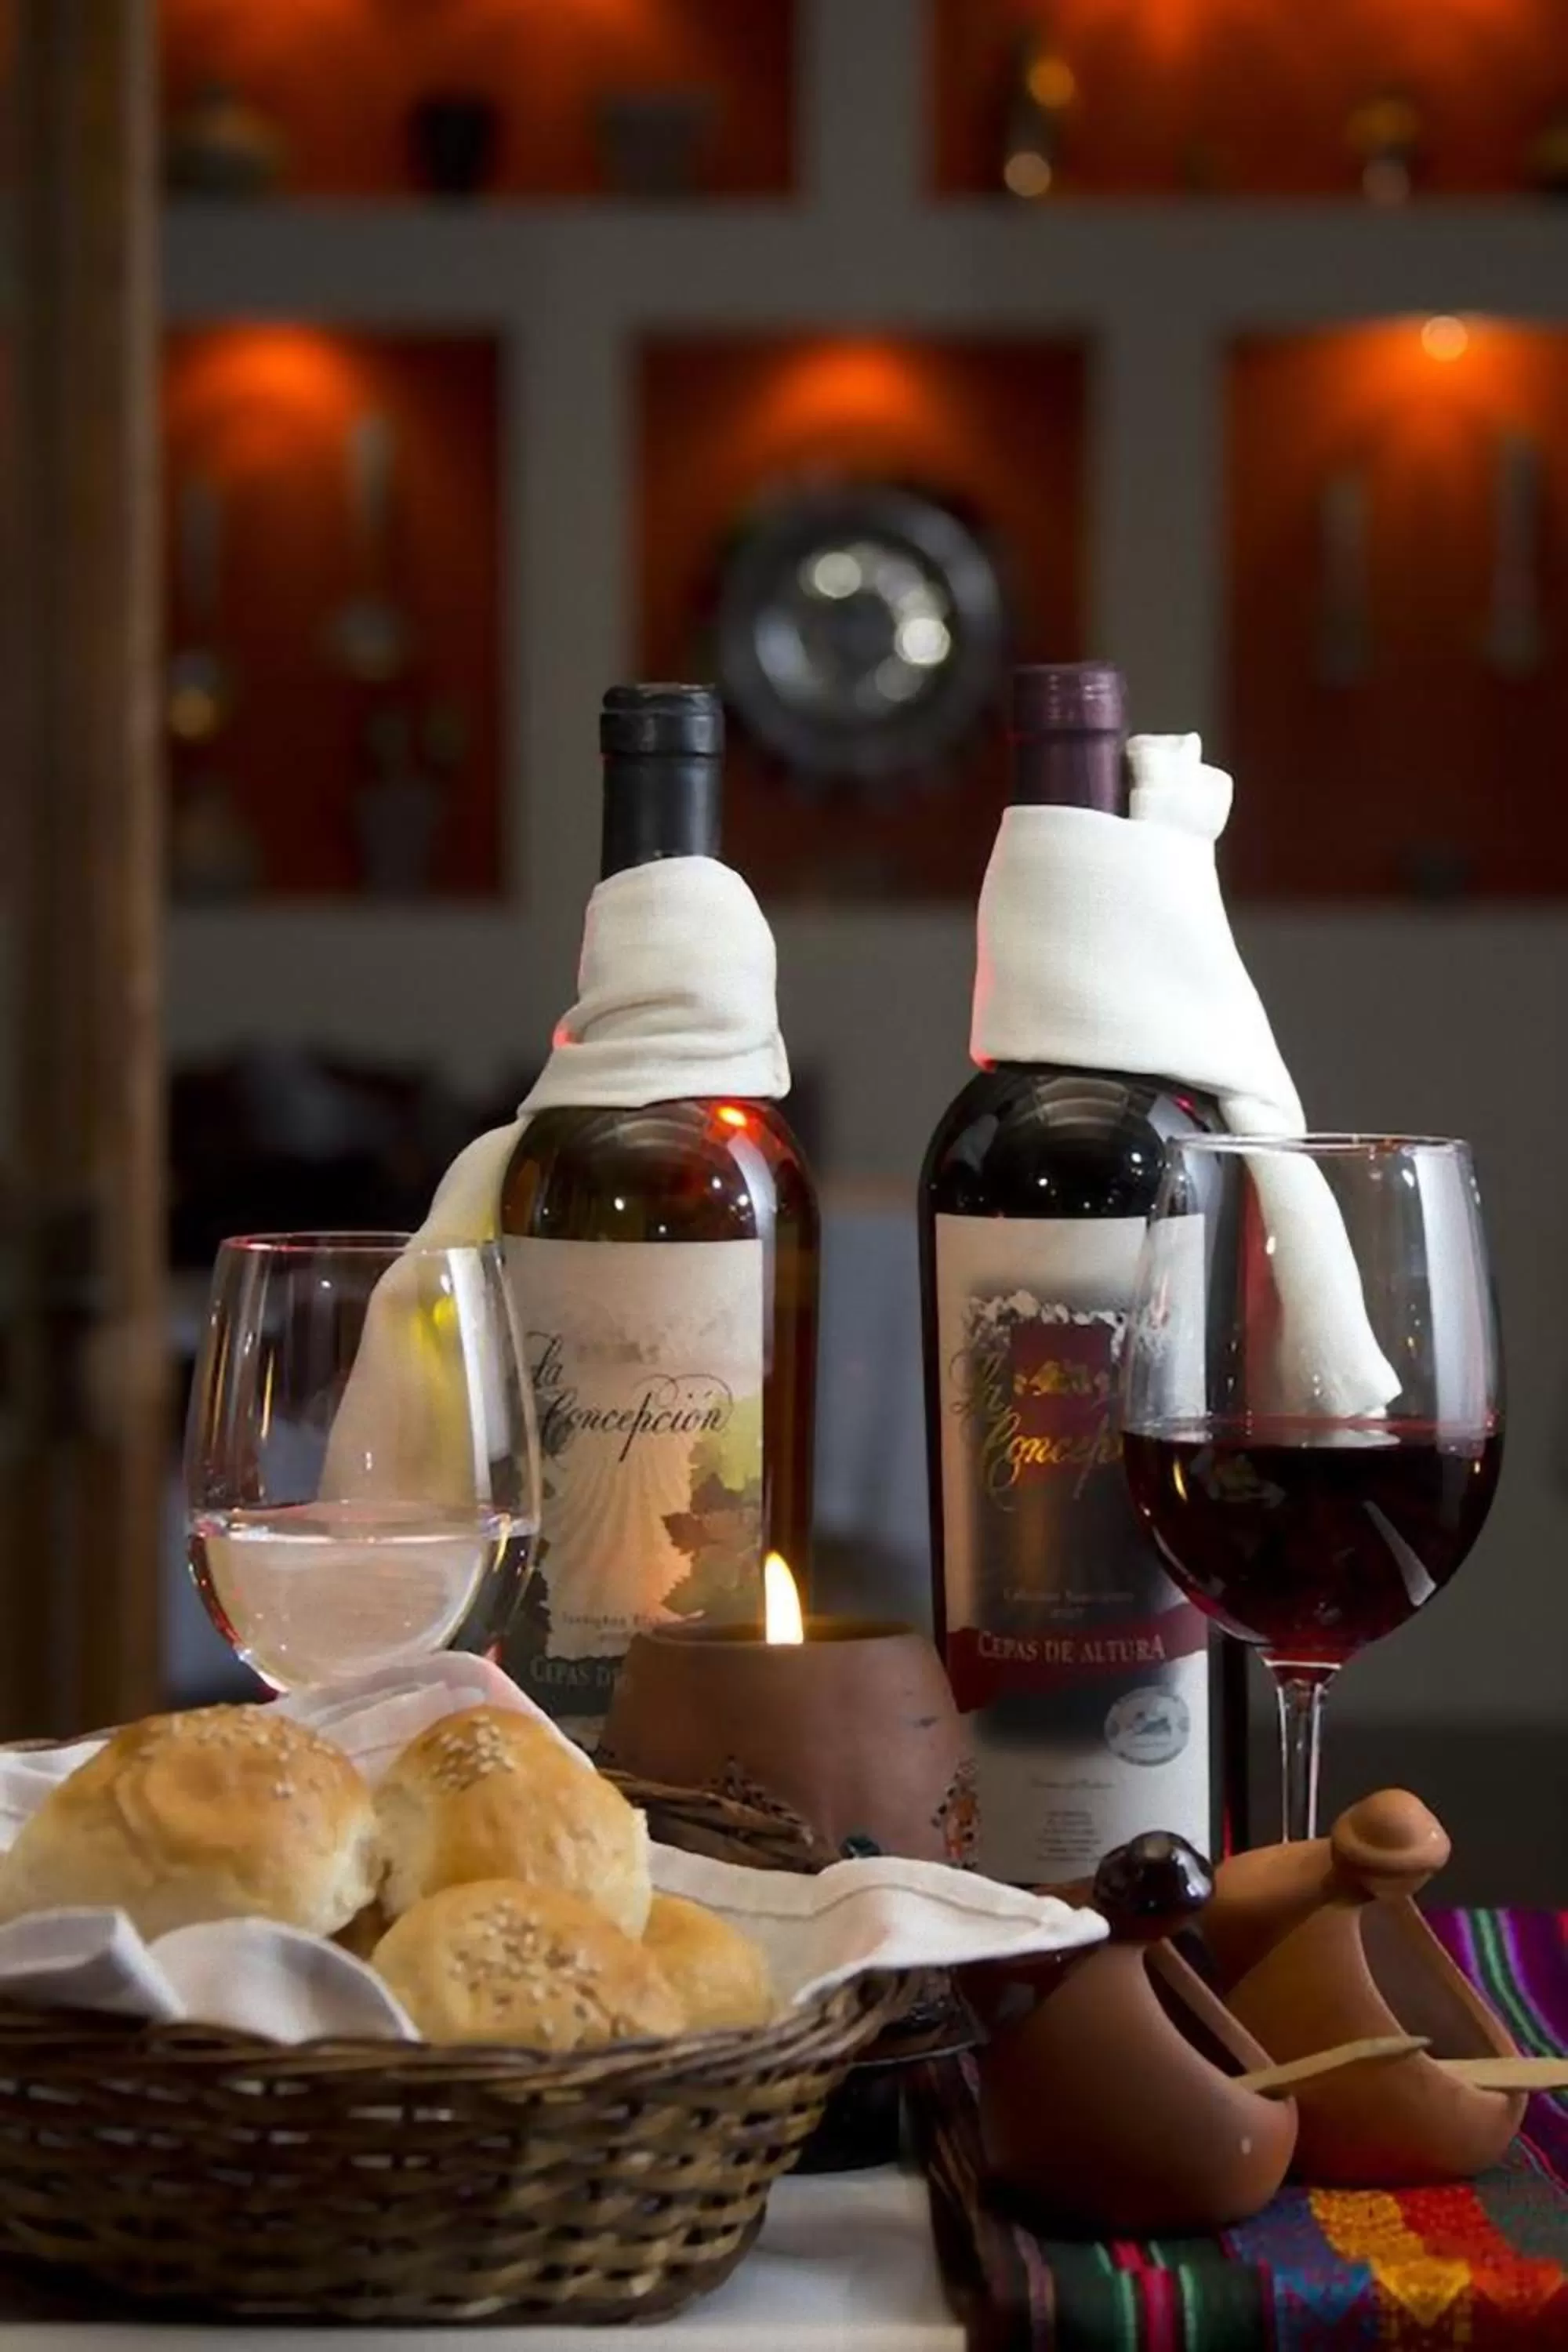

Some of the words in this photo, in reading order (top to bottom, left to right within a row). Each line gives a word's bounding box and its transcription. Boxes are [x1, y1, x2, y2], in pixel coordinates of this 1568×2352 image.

[536, 1374, 734, 1463] Concepción
[979, 1630, 1038, 1661] CEPAS
[1044, 1639, 1074, 1664] DE
[1079, 1633, 1166, 1663] ALTURA
